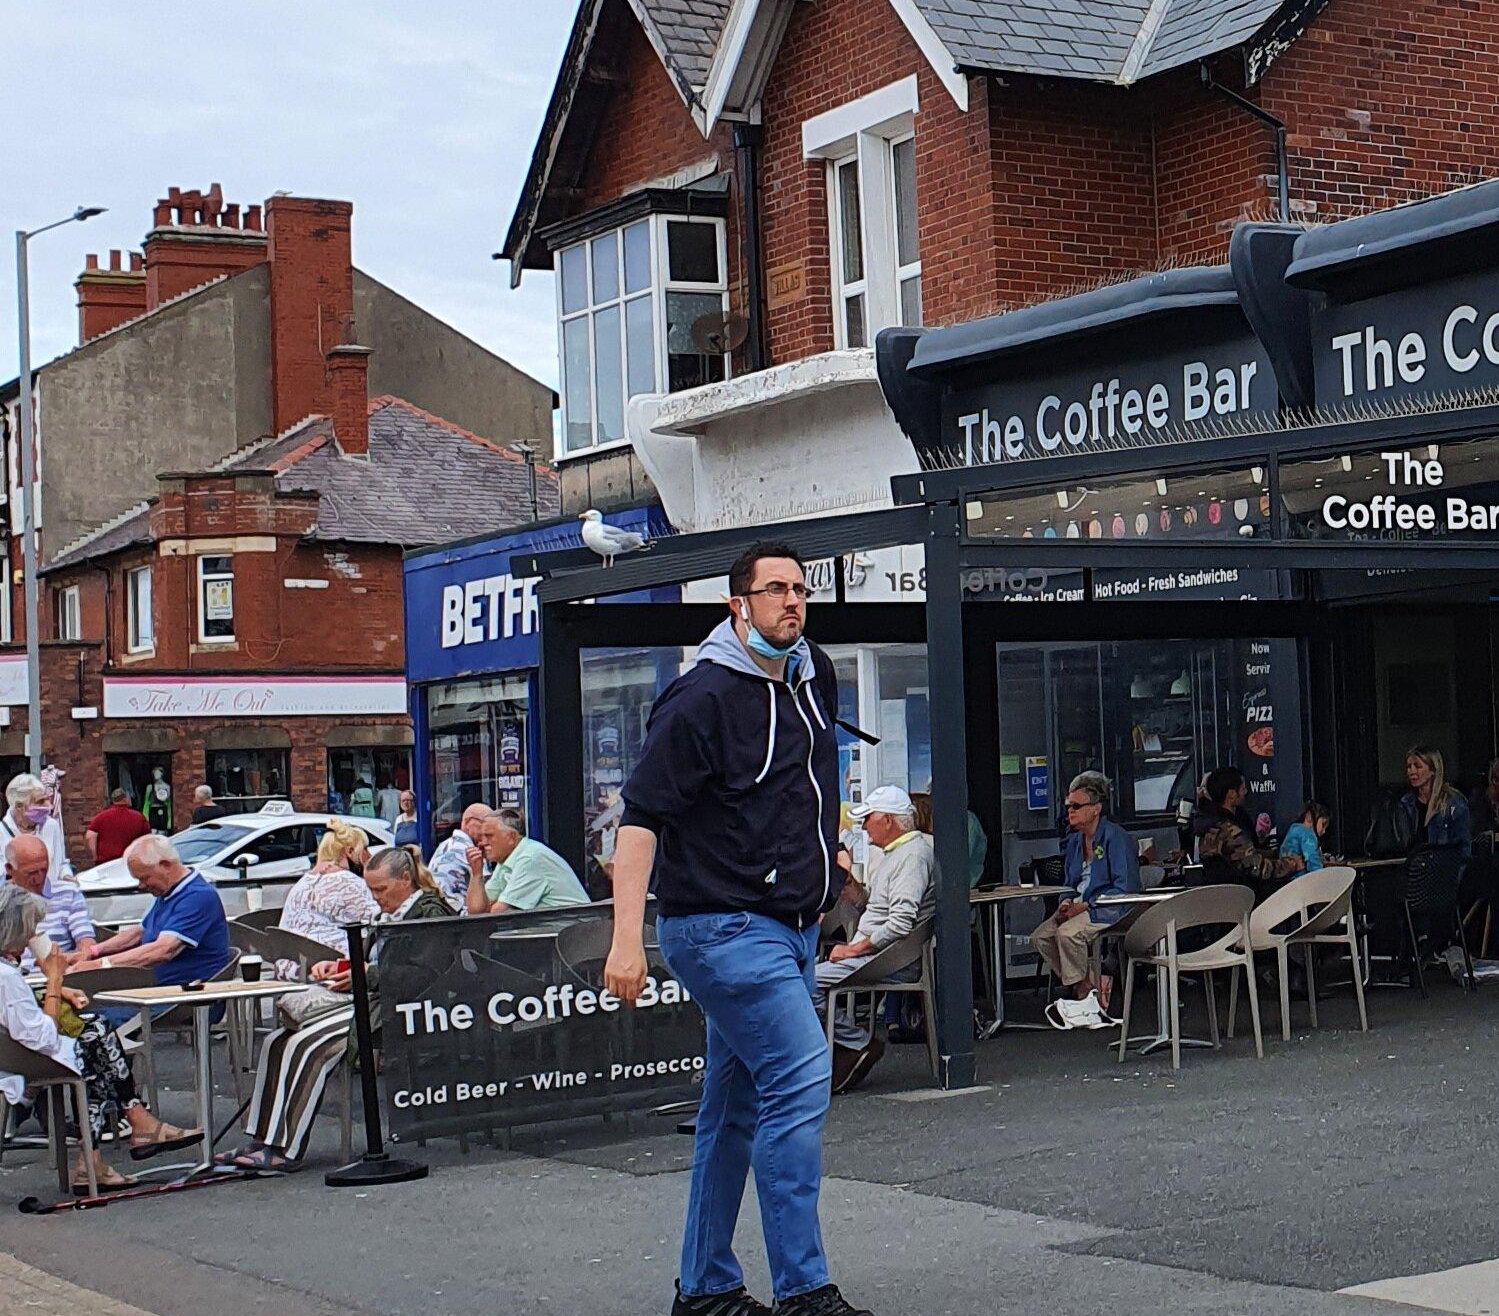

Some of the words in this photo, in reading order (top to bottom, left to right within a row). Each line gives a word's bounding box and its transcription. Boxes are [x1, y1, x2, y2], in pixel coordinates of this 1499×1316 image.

[1332, 325, 1428, 397] The
[957, 408, 1025, 466] The
[1036, 379, 1169, 452] Coffee
[1183, 360, 1257, 422] Bar
[1380, 451, 1444, 486] The
[1322, 495, 1436, 530] Coffee
[1095, 582, 1113, 599] Hot
[1114, 578, 1140, 596] Food
[1149, 573, 1175, 592] Fresh
[1177, 567, 1239, 588] Sandwiches
[441, 573, 543, 649] BETFR
[186, 686, 225, 713] Me
[1249, 780, 1276, 793] Waffl
[395, 999, 474, 1036] The
[487, 984, 621, 1026] Coffee
[394, 1084, 447, 1109] Cold
[456, 1080, 508, 1102] Beer
[532, 1069, 588, 1091] Wine
[610, 1055, 706, 1081] Prosecco
